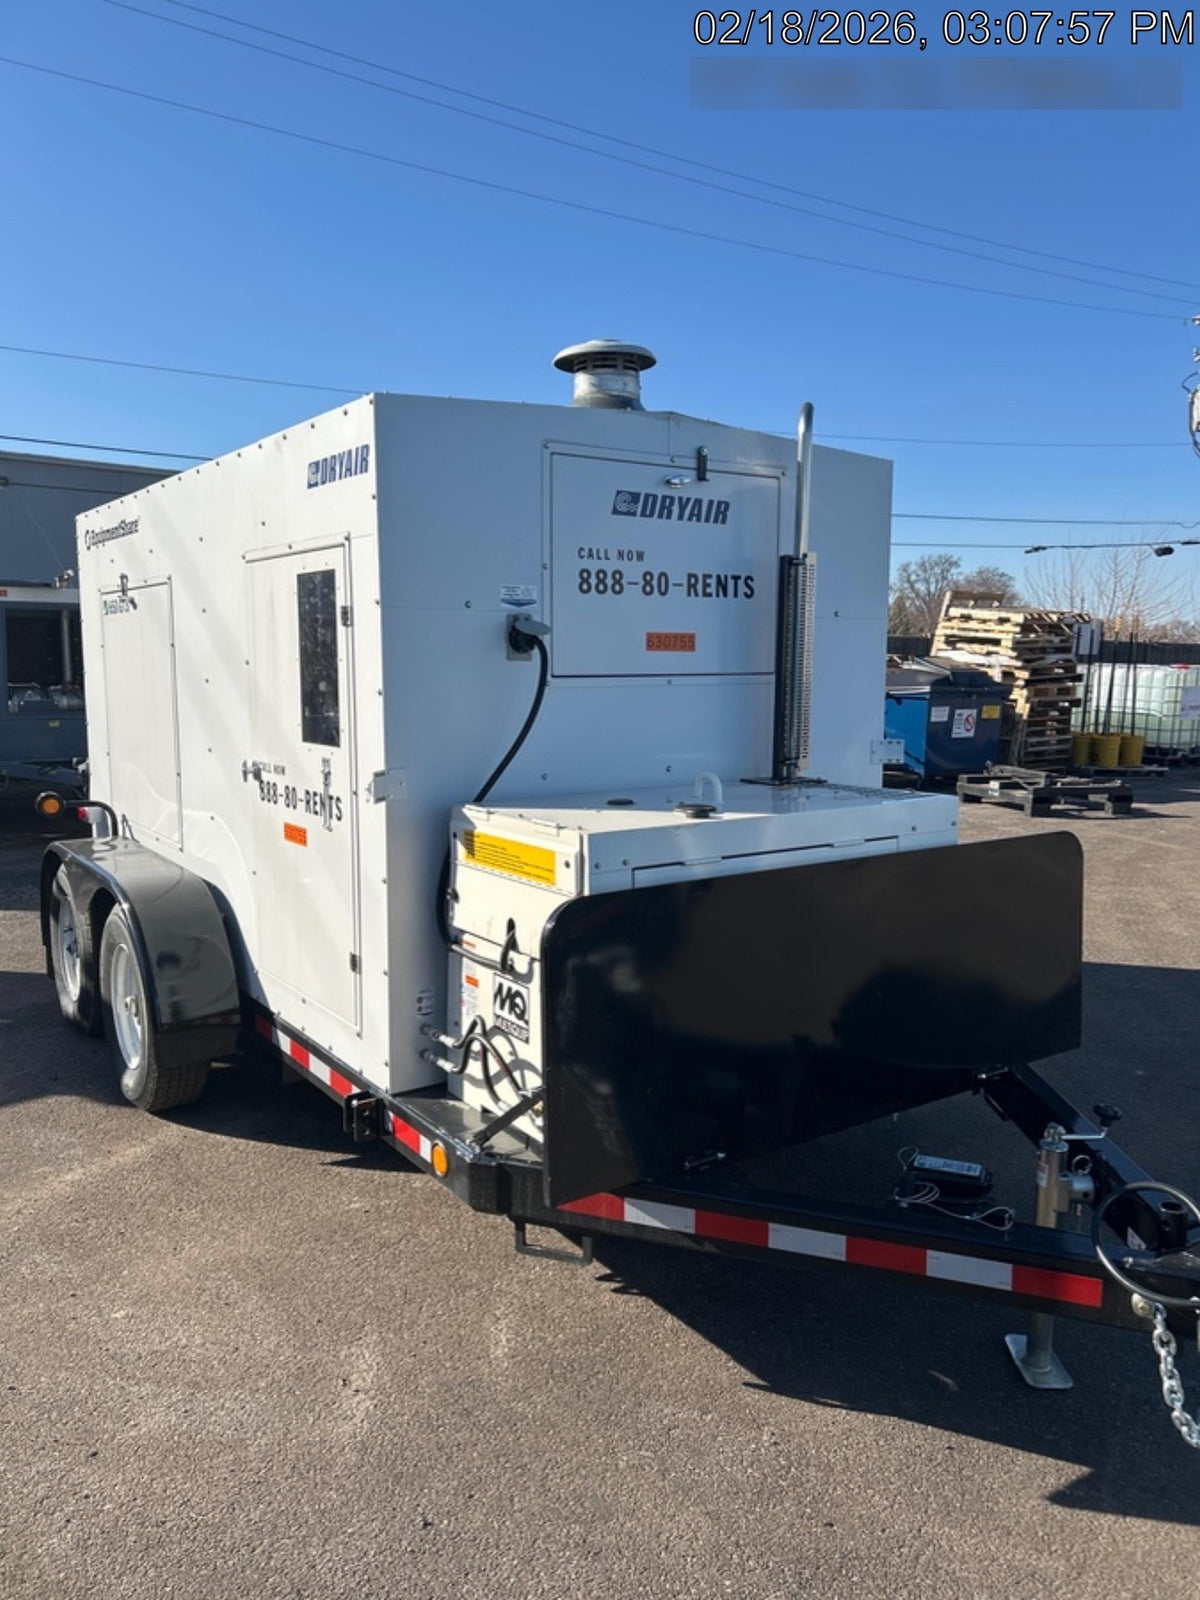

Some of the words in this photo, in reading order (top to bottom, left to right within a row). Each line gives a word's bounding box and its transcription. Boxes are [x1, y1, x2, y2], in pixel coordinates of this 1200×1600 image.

[320, 443, 370, 486] DRYAIR
[640, 492, 731, 525] DRYAIR
[577, 546, 611, 561] CALL
[617, 549, 646, 562] NOW
[578, 568, 756, 599] 888-80-RENTS
